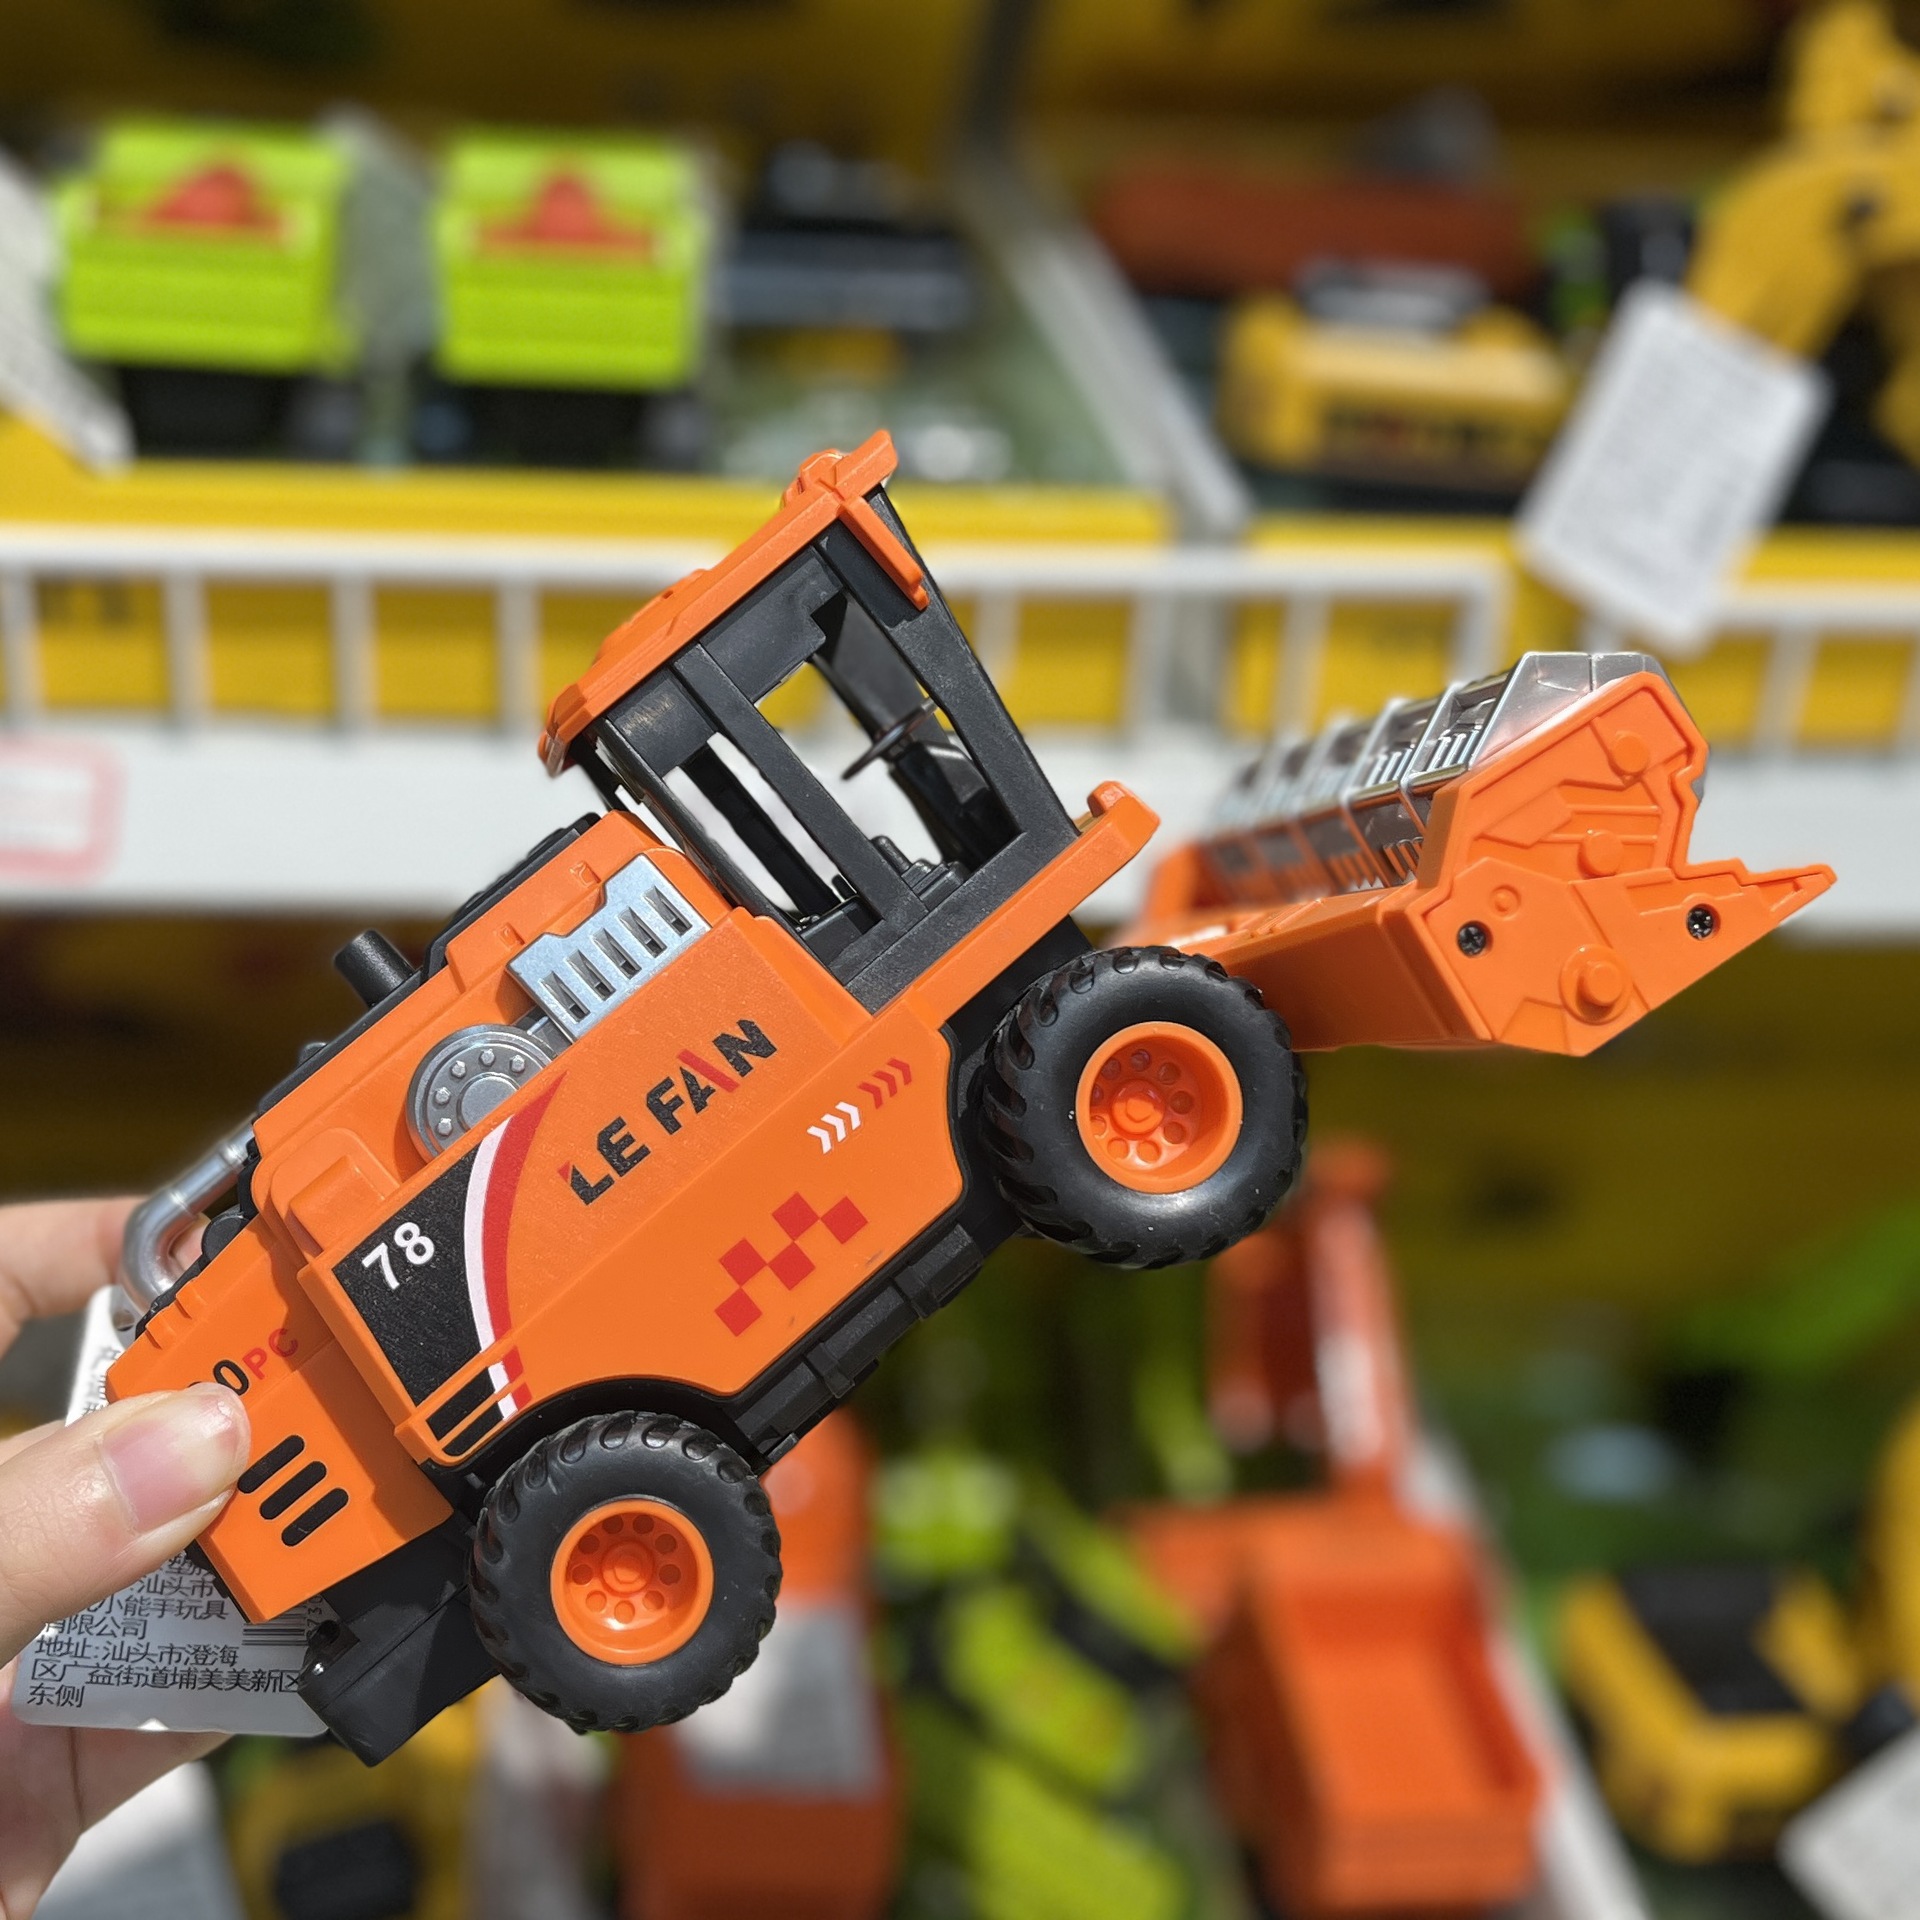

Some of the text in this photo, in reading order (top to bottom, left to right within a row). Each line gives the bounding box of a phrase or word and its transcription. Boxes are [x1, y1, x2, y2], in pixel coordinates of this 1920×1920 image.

[558, 1019, 778, 1206] LE FAN
[361, 1220, 435, 1291] 78
[87, 1594, 229, 1621] 小能手玩具
[35, 1635, 240, 1668] 地址:汕头市澄海
[26, 1682, 86, 1709] 东侧
